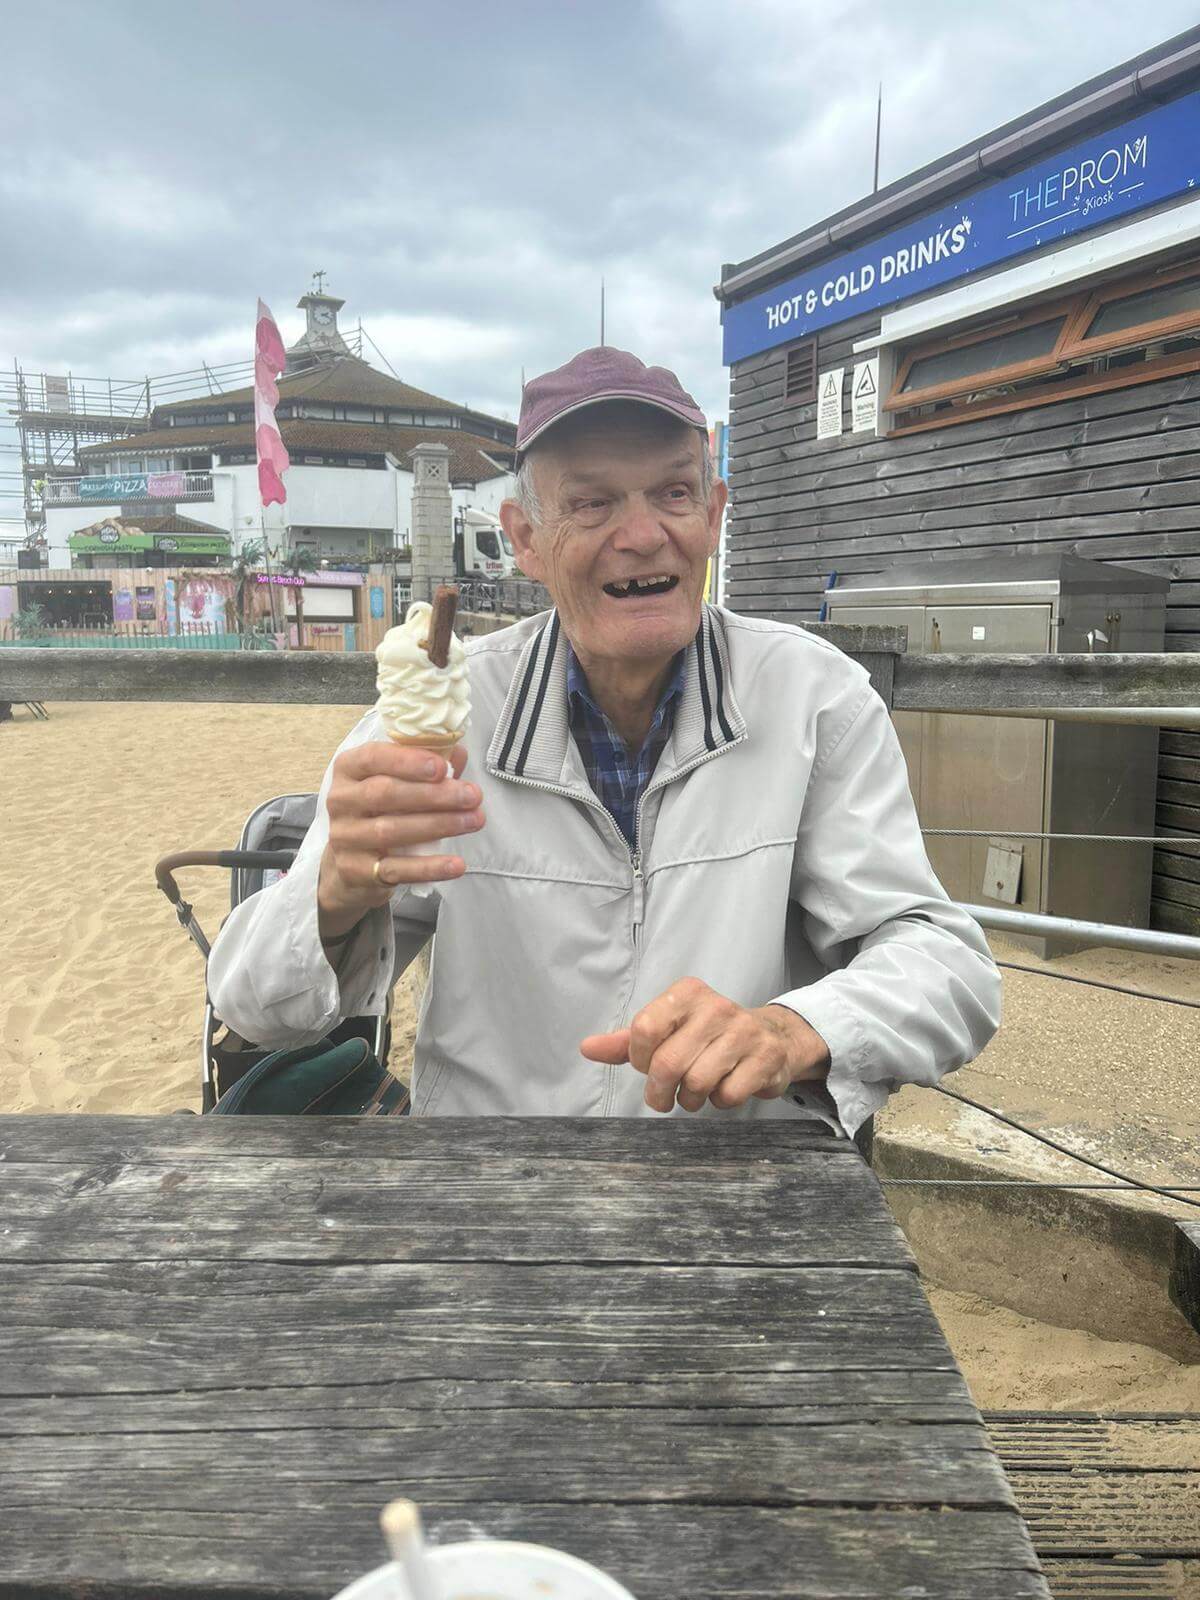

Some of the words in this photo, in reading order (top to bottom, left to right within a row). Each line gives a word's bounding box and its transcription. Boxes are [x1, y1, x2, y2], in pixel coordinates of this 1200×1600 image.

[1083, 188, 1114, 216] Kiosk
[767, 294, 801, 330] HOT
[805, 289, 818, 315] &
[821, 264, 875, 307] COLD
[880, 223, 967, 284] DRINKS
[114, 479, 147, 493] PIZZA
[257, 573, 276, 583] Sunet
